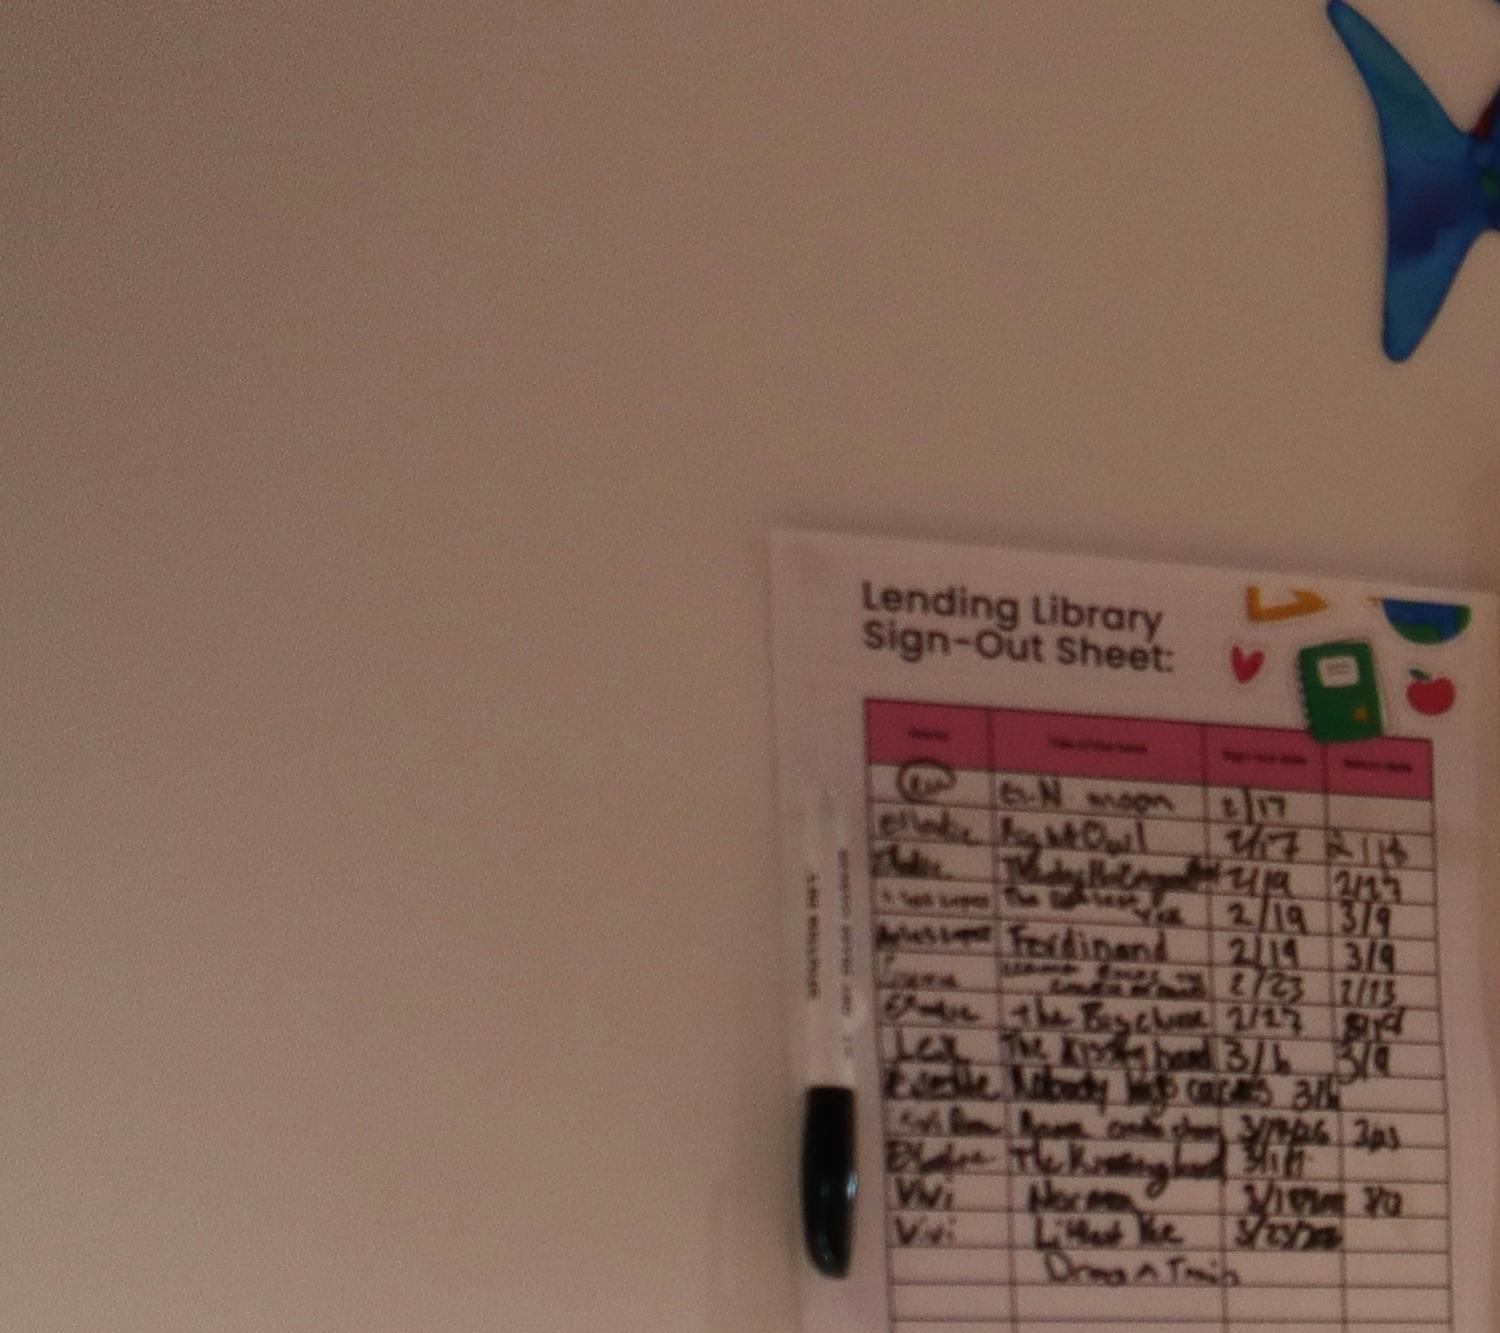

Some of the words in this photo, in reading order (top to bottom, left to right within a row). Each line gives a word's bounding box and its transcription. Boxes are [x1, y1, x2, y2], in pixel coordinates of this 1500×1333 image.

[861, 580, 1021, 633] Lending
[1029, 594, 1163, 641] Library
[863, 618, 1045, 664] Sign-Out
[1056, 635, 1175, 673] Sheet:
[1341, 900, 1392, 937] 3/9
[1008, 925, 1168, 963] Ferdinand
